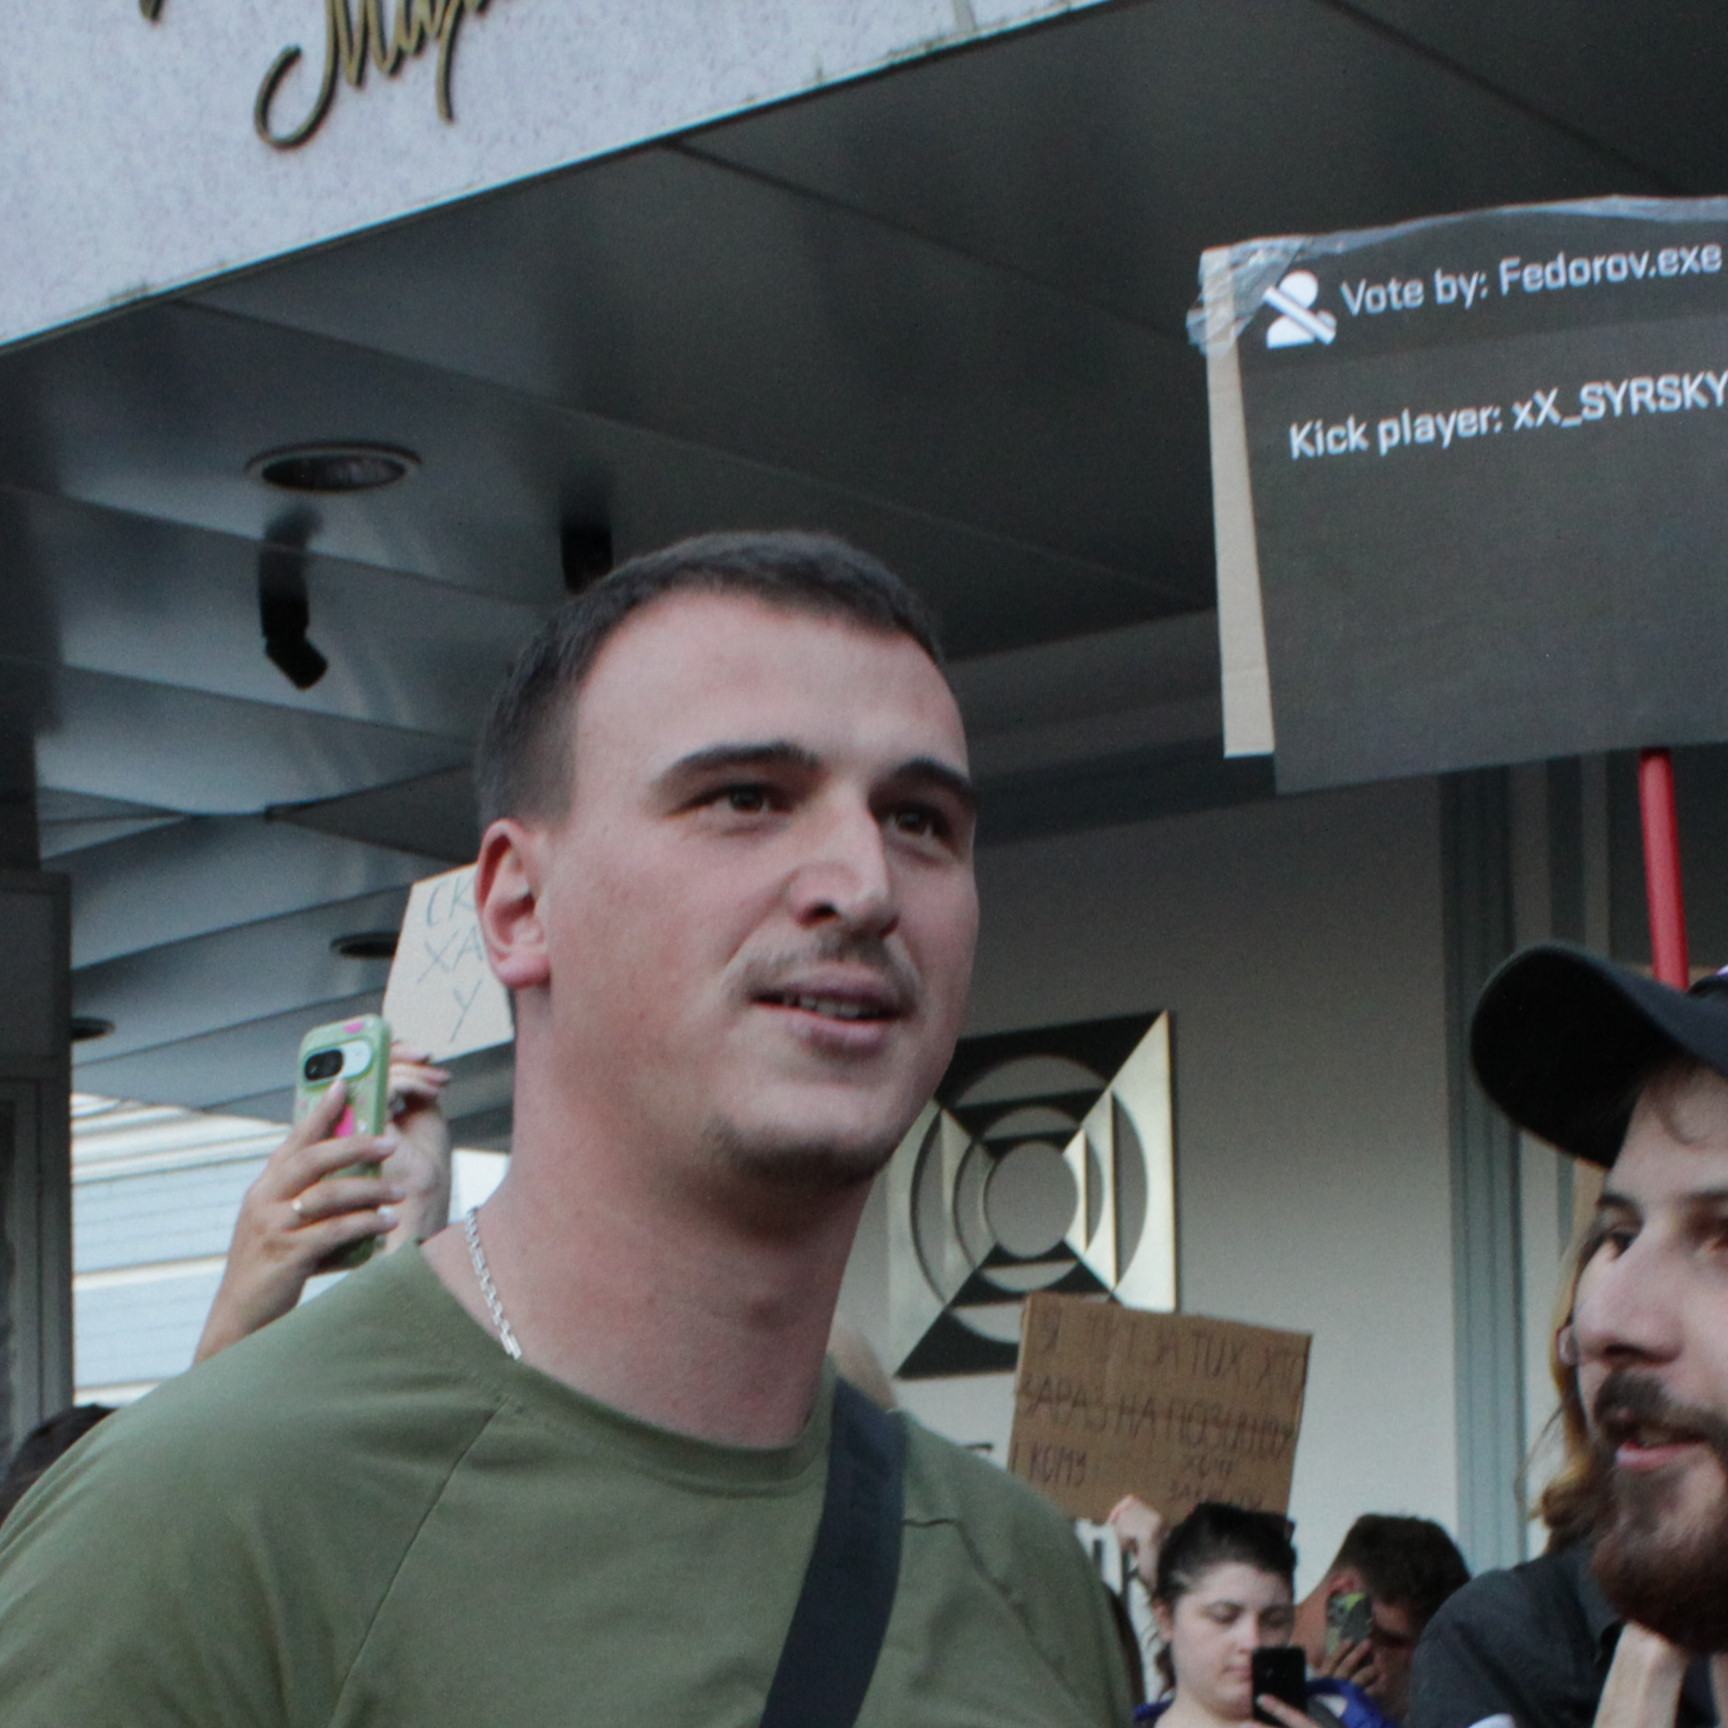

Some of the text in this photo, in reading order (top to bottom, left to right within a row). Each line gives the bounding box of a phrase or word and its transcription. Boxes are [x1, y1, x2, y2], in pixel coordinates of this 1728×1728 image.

[1341, 240, 1723, 317] Vote by: Fedorov.exe
[1288, 419, 1368, 460] Kick
[1378, 405, 1503, 453] player:
